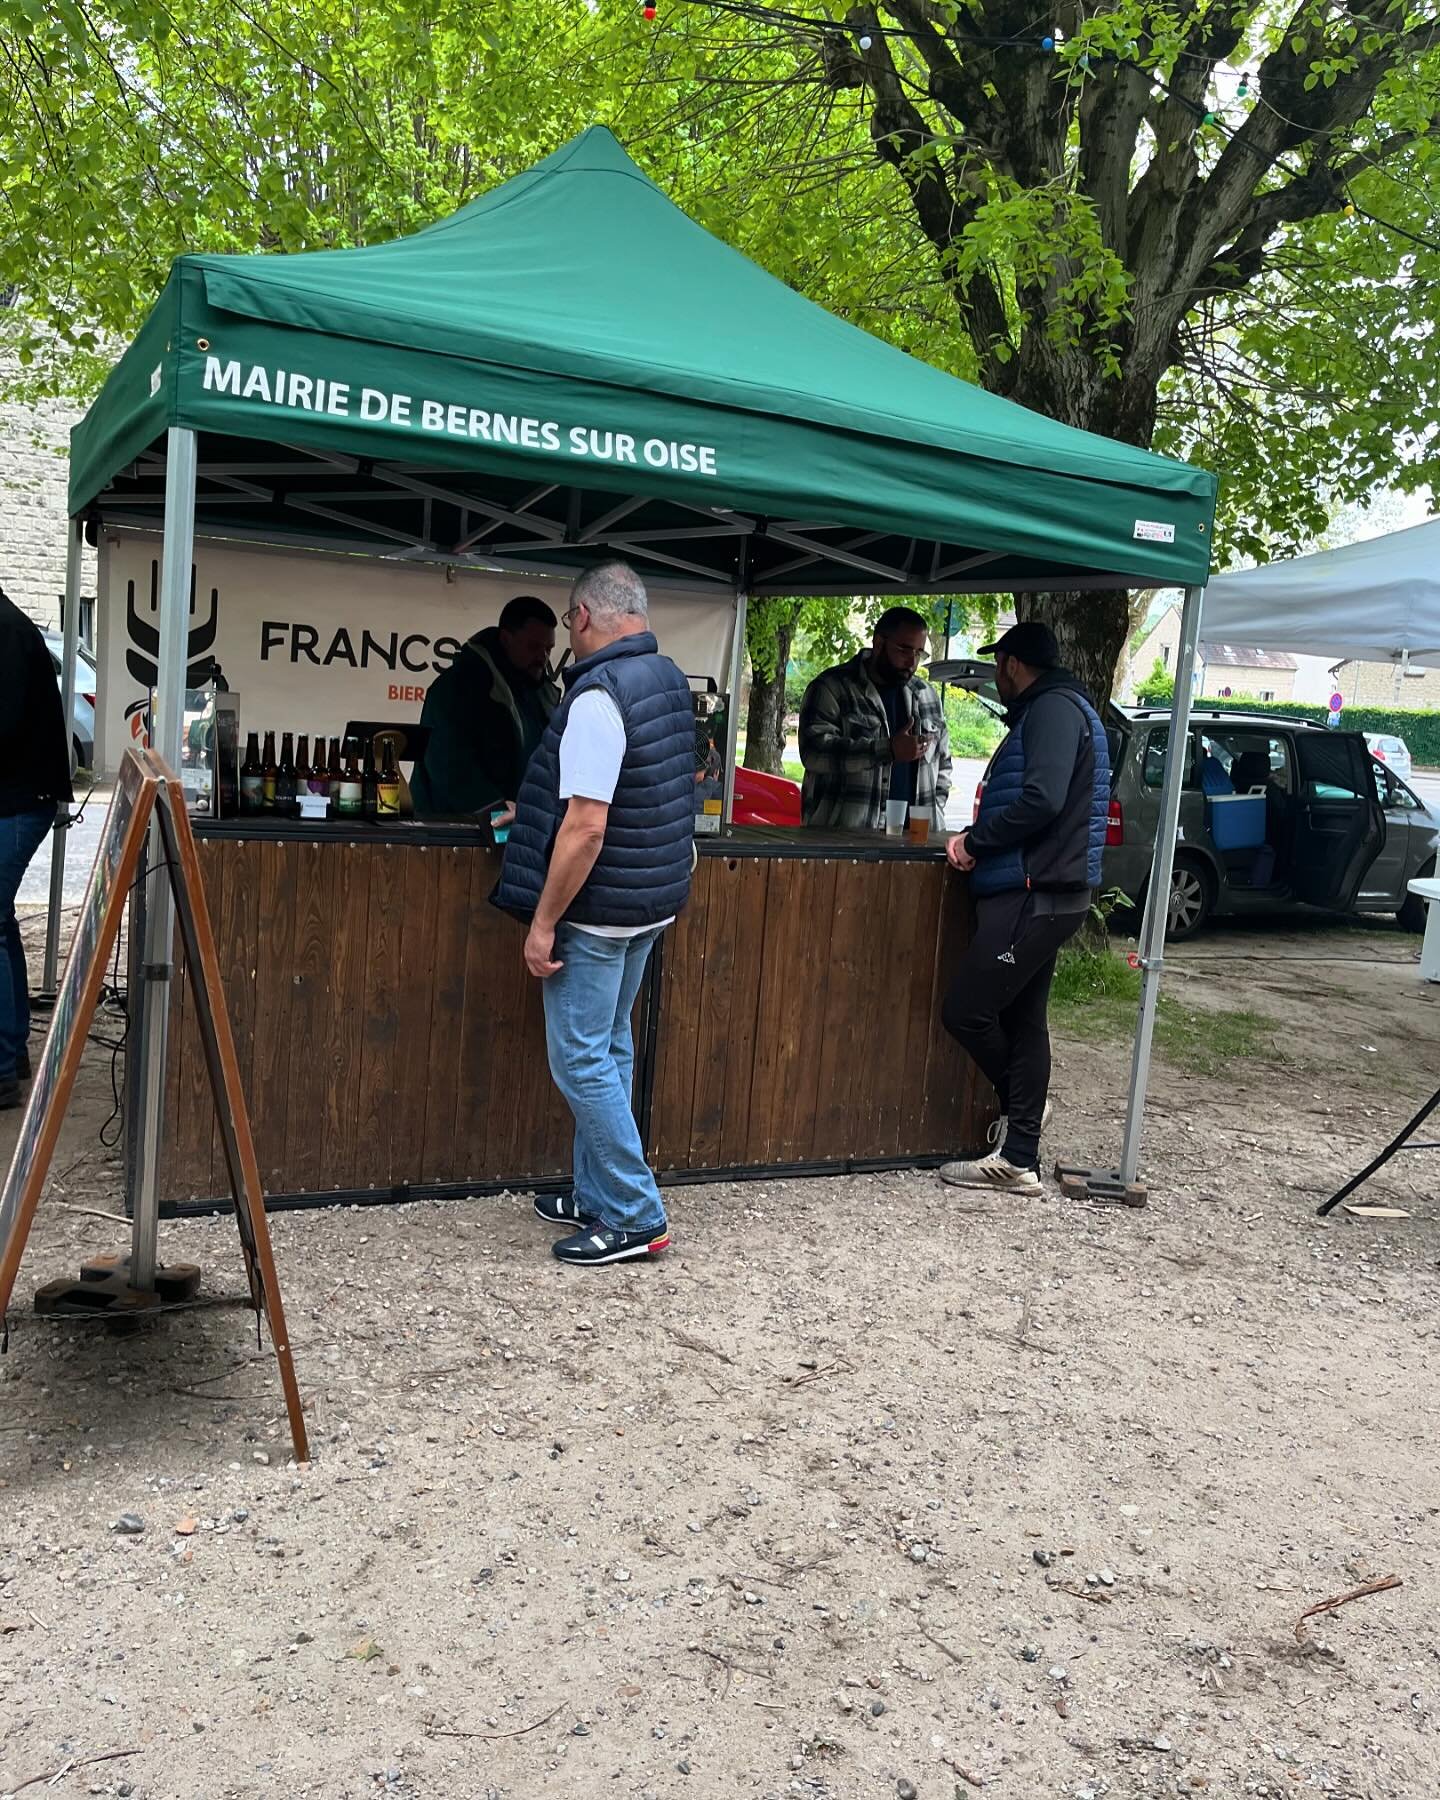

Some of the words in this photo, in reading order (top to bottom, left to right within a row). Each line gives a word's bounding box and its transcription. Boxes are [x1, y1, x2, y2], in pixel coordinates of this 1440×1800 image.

[202, 356, 350, 417] MAIRIE
[359, 388, 412, 428] DE
[421, 400, 560, 451] BERNES
[569, 427, 637, 464] SUR
[643, 439, 718, 476] OISE
[260, 621, 462, 674] FRANCS
[388, 684, 425, 702] BIER
